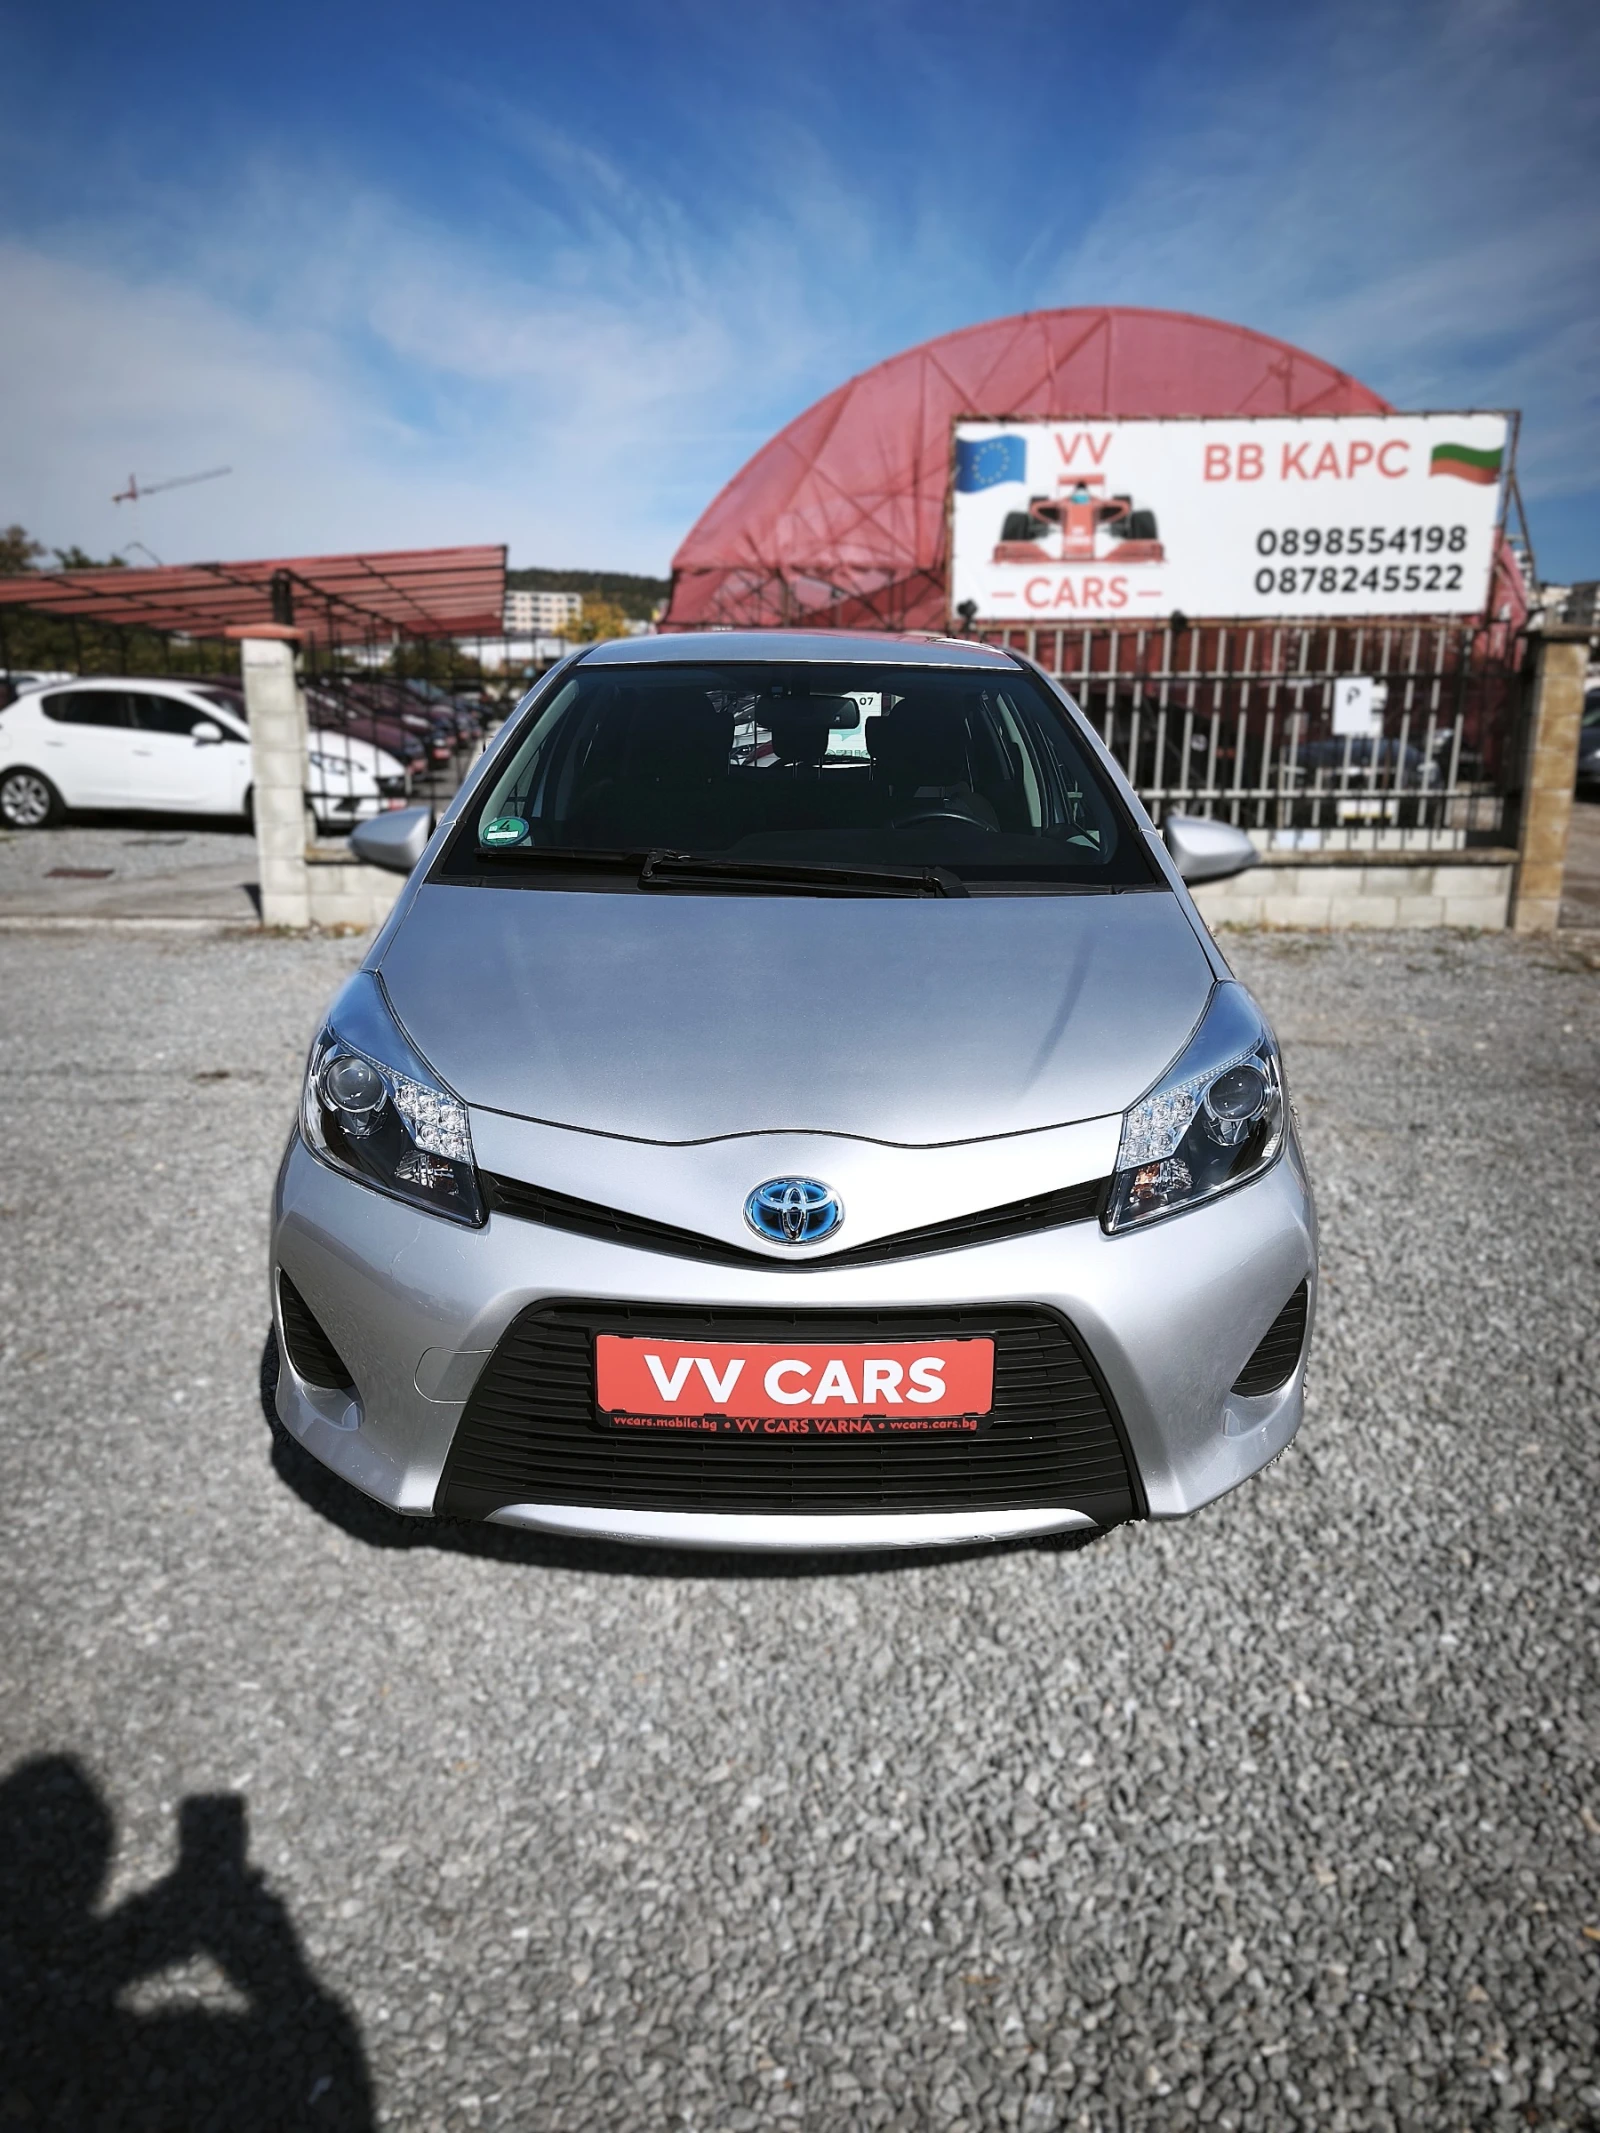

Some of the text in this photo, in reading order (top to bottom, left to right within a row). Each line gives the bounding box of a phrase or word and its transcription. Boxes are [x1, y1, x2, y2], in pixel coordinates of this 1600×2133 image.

[1055, 433, 1113, 466] VV
[1203, 440, 1410, 482] ВВ КАРС
[1256, 525, 1467, 557] 0898554198
[1024, 576, 1128, 609] CARS
[1254, 564, 1463, 595] 0878245522
[859, 697, 873, 706] 07
[498, 820, 511, 832] 4
[644, 1354, 946, 1405] VV CARS
[613, 1415, 978, 1433] vvcars.mobile.bg VV CARS VARNA vvcars.cars.bg
